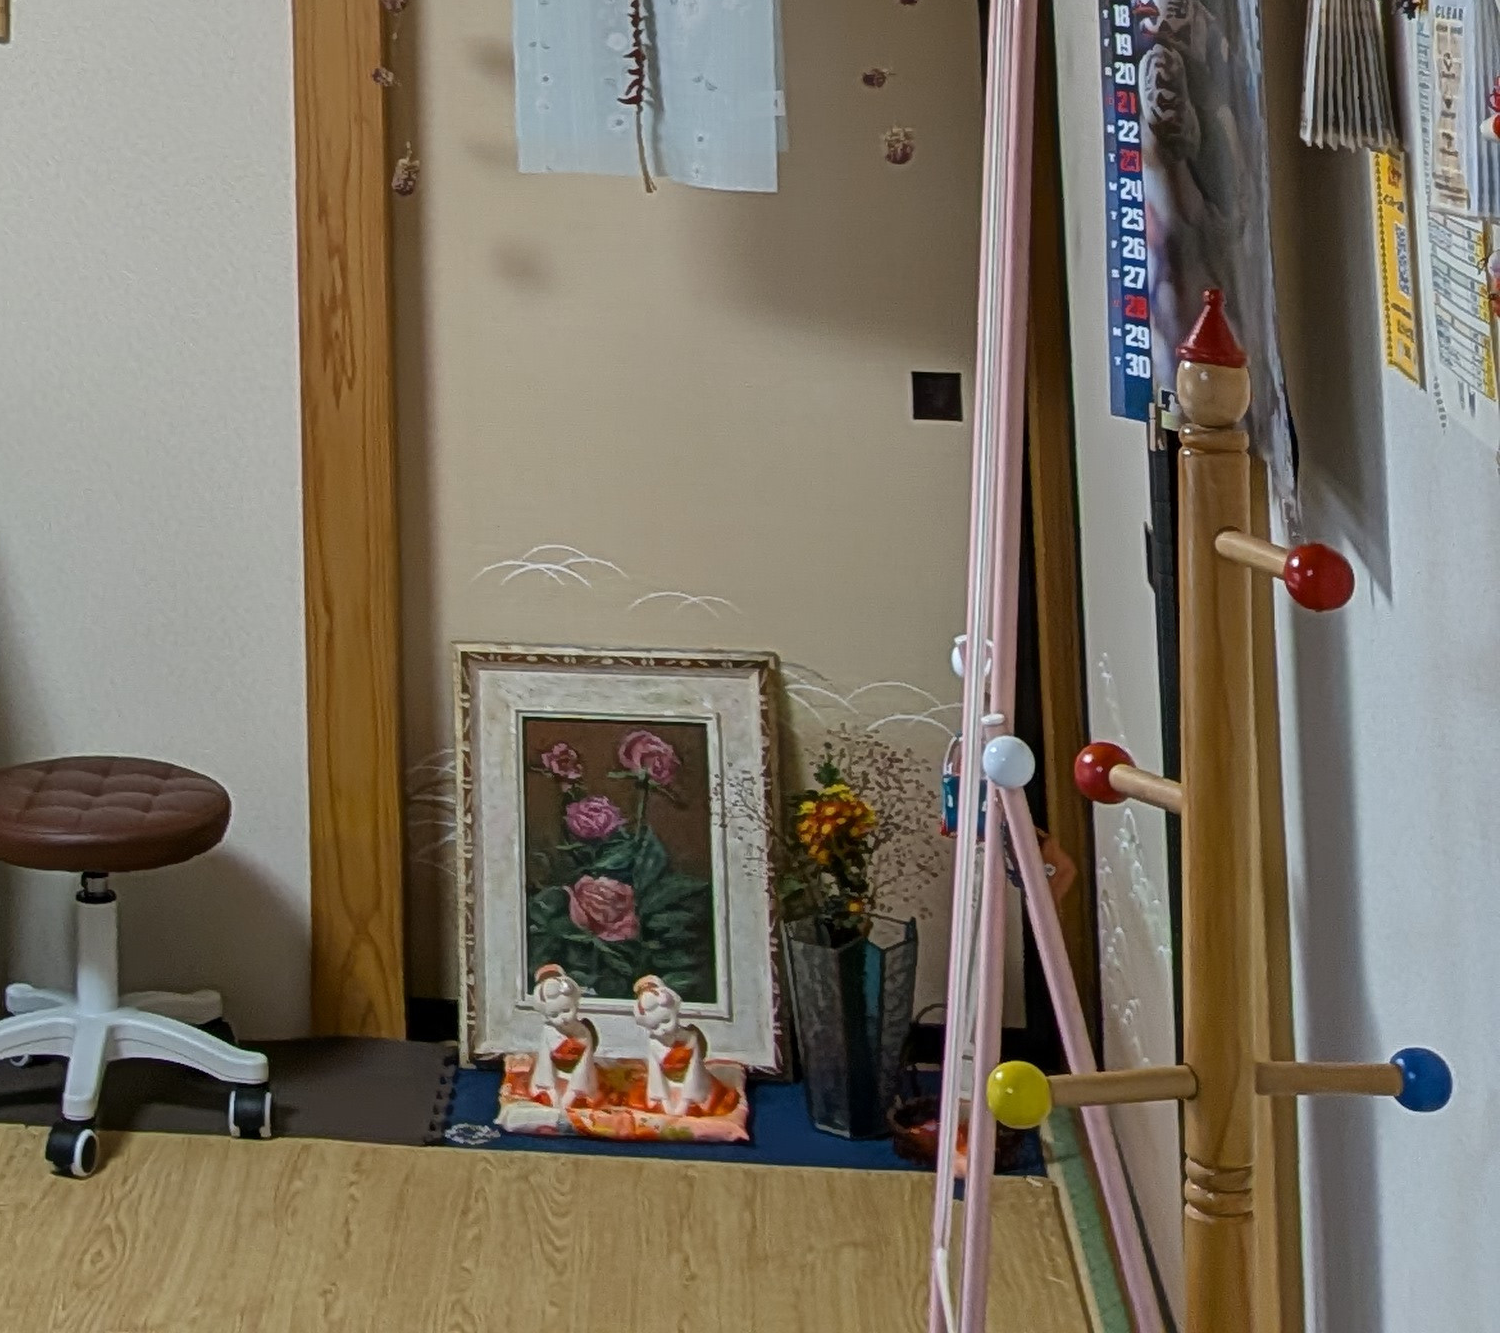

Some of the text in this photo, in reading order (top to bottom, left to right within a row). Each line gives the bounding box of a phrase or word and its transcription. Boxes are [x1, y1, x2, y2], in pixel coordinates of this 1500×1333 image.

[1113, 4, 1130, 28] 18
[1115, 32, 1133, 56] 19
[1114, 62, 1135, 85] 20
[1116, 91, 1137, 114] 21
[1117, 119, 1140, 143] 22
[1119, 148, 1141, 173] 23
[1120, 177, 1143, 202] 24
[1121, 206, 1144, 231] 25
[1122, 235, 1146, 260] 26
[1123, 265, 1146, 289] 27
[1125, 323, 1150, 349] 29
[1125, 352, 1151, 378] 30
